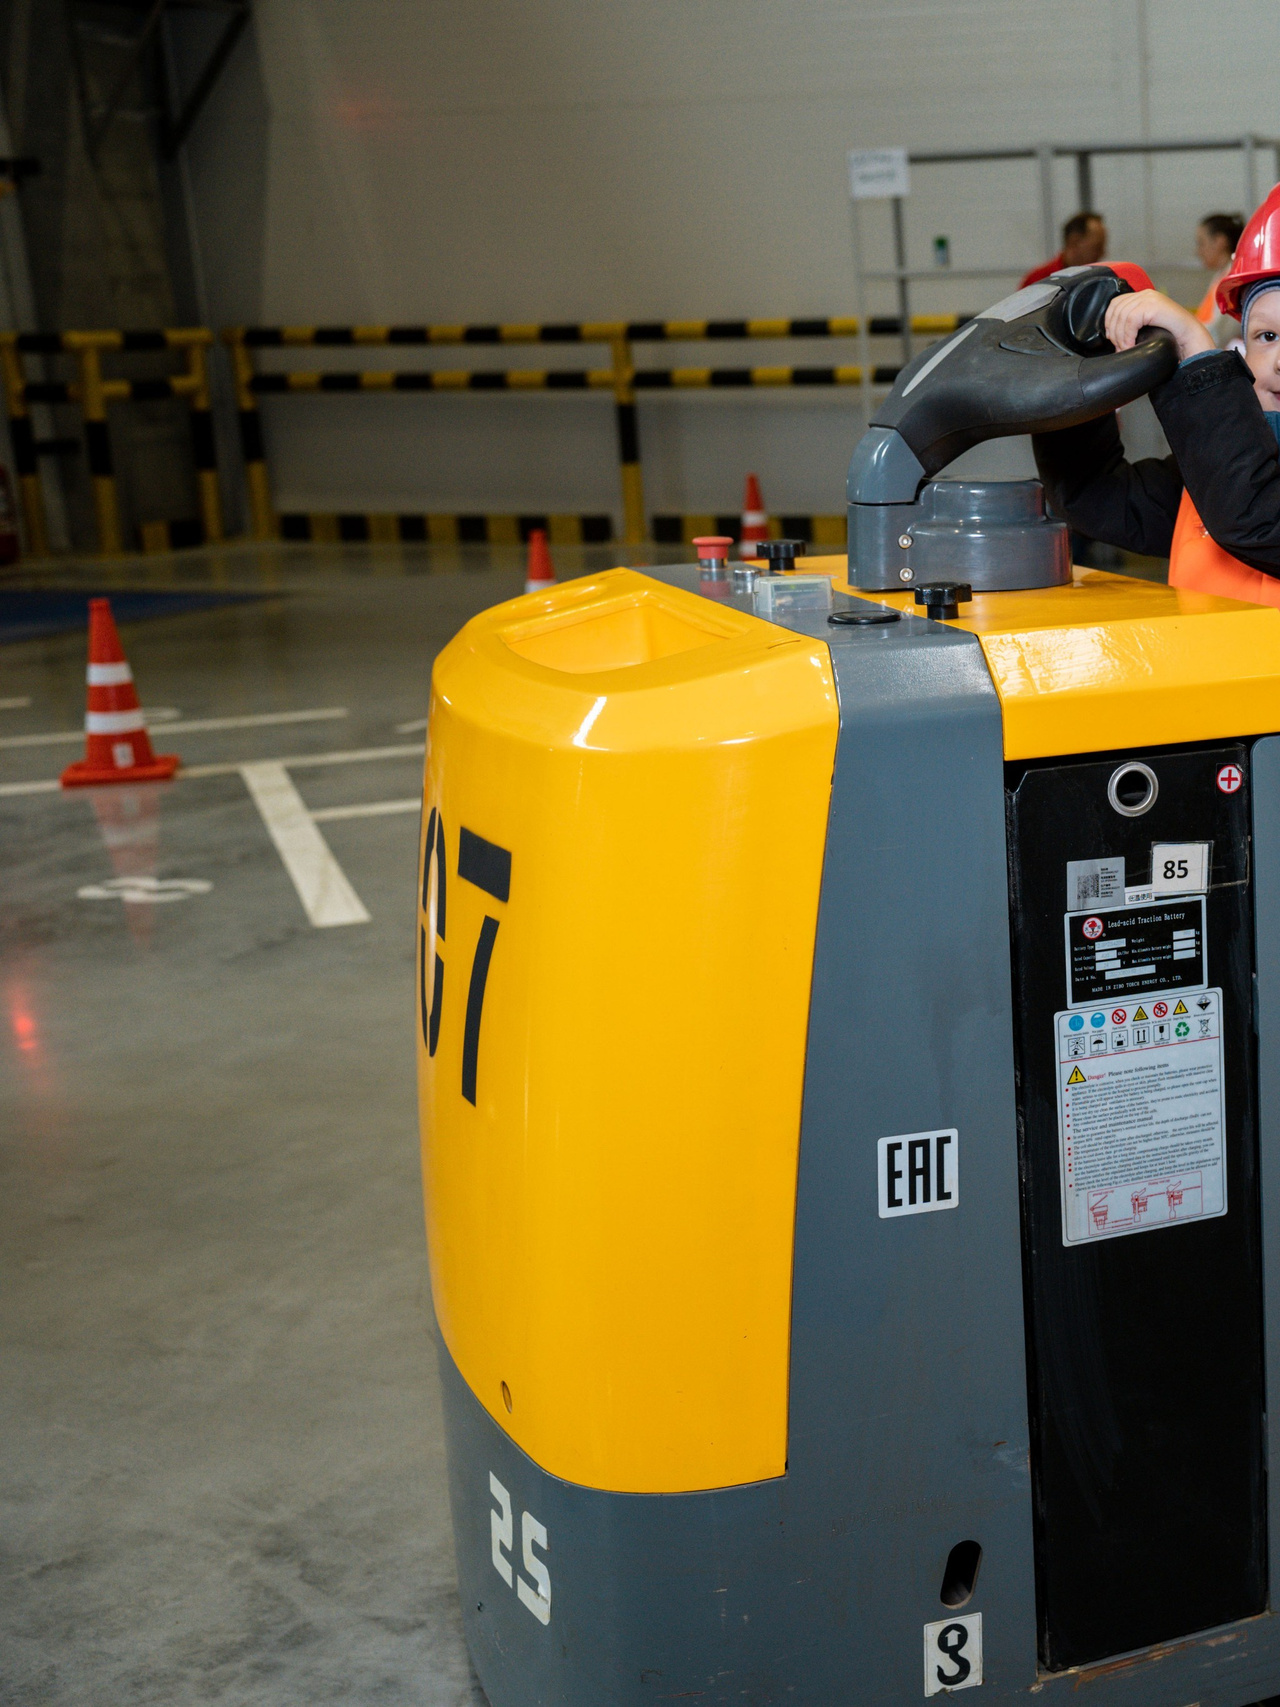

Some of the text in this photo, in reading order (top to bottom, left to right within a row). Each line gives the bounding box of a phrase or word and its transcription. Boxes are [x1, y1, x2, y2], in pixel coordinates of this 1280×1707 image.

[1163, 860, 1188, 879] 85
[1108, 911, 1185, 928] Lead-acid Traction Battery
[1142, 978, 1157, 986] ENERGY
[887, 1136, 951, 1208] EAC
